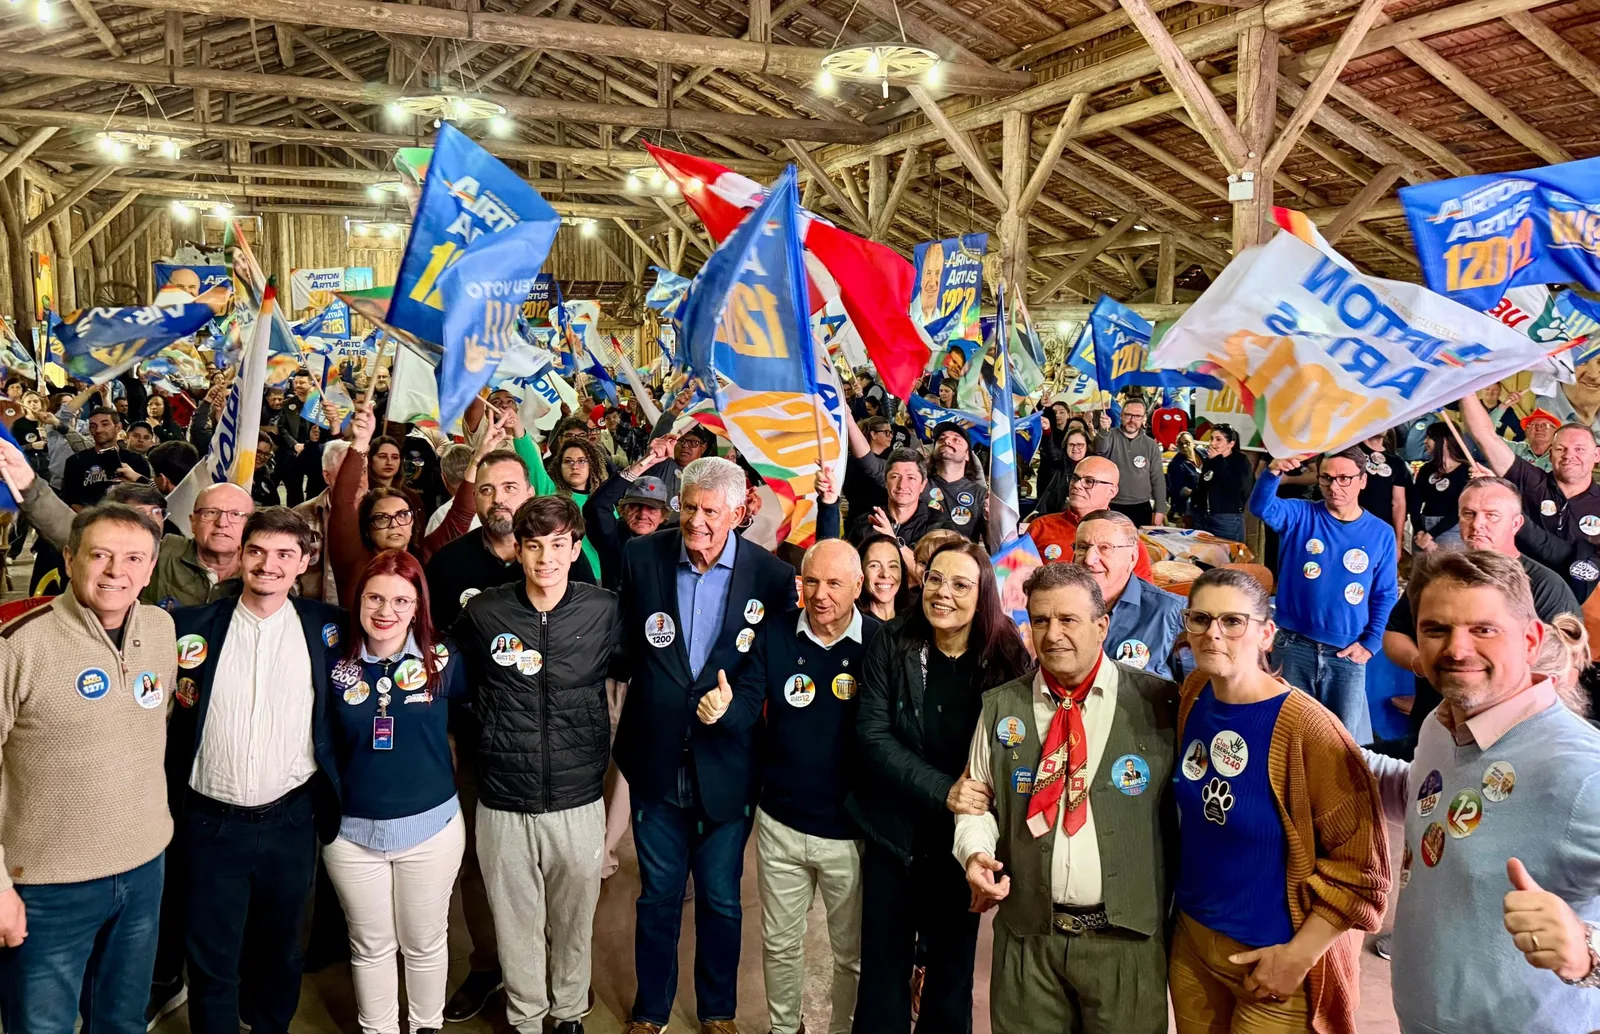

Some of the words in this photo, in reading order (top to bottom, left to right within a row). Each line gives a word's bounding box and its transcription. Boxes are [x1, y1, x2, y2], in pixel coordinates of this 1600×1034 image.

[447, 175, 517, 233] AIRT
[1446, 197, 1532, 243] ARTUS
[1443, 217, 1536, 291] 12012
[305, 272, 339, 280] AIRTON
[946, 270, 977, 286] ARTUS
[311, 281, 340, 289] ARTUS
[527, 291, 549, 299] RTUS
[522, 301, 550, 318] 2012
[1306, 566, 1319, 575] 12
[653, 635, 671, 643] 1200
[182, 640, 204, 661] 12
[331, 668, 356, 685] 1200
[401, 665, 420, 685] 12
[83, 682, 104, 694] 1277
[154, 692, 161, 700] 12
[1215, 737, 1230, 749] Clau
[1222, 754, 1241, 770] 1240
[1194, 767, 1201, 777] 12
[1452, 795, 1478, 833] 12
